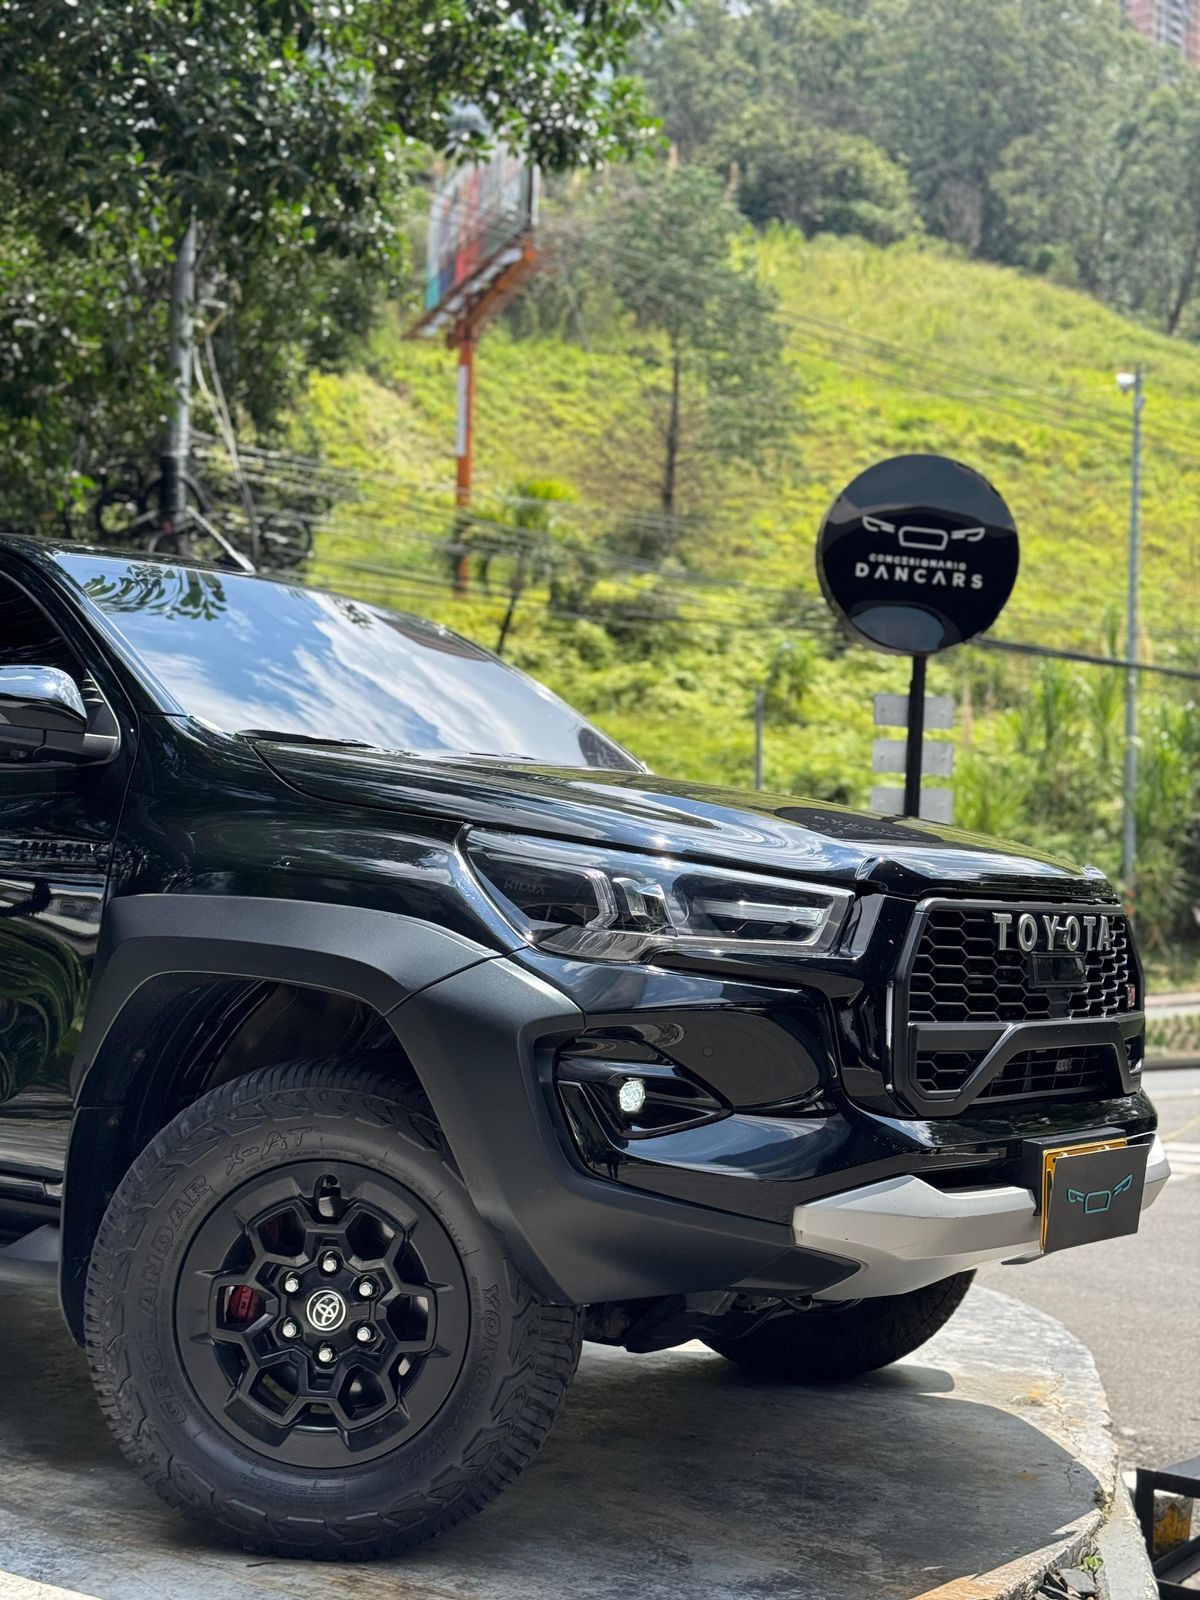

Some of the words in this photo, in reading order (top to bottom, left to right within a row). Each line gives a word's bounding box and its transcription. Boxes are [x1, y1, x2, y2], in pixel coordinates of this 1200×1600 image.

[854, 562, 984, 590] DANCARS
[868, 553, 968, 571] CONCESIONARIO
[992, 912, 1113, 952] TOYOTA
[138, 1173, 212, 1424] GEOLANDAR
